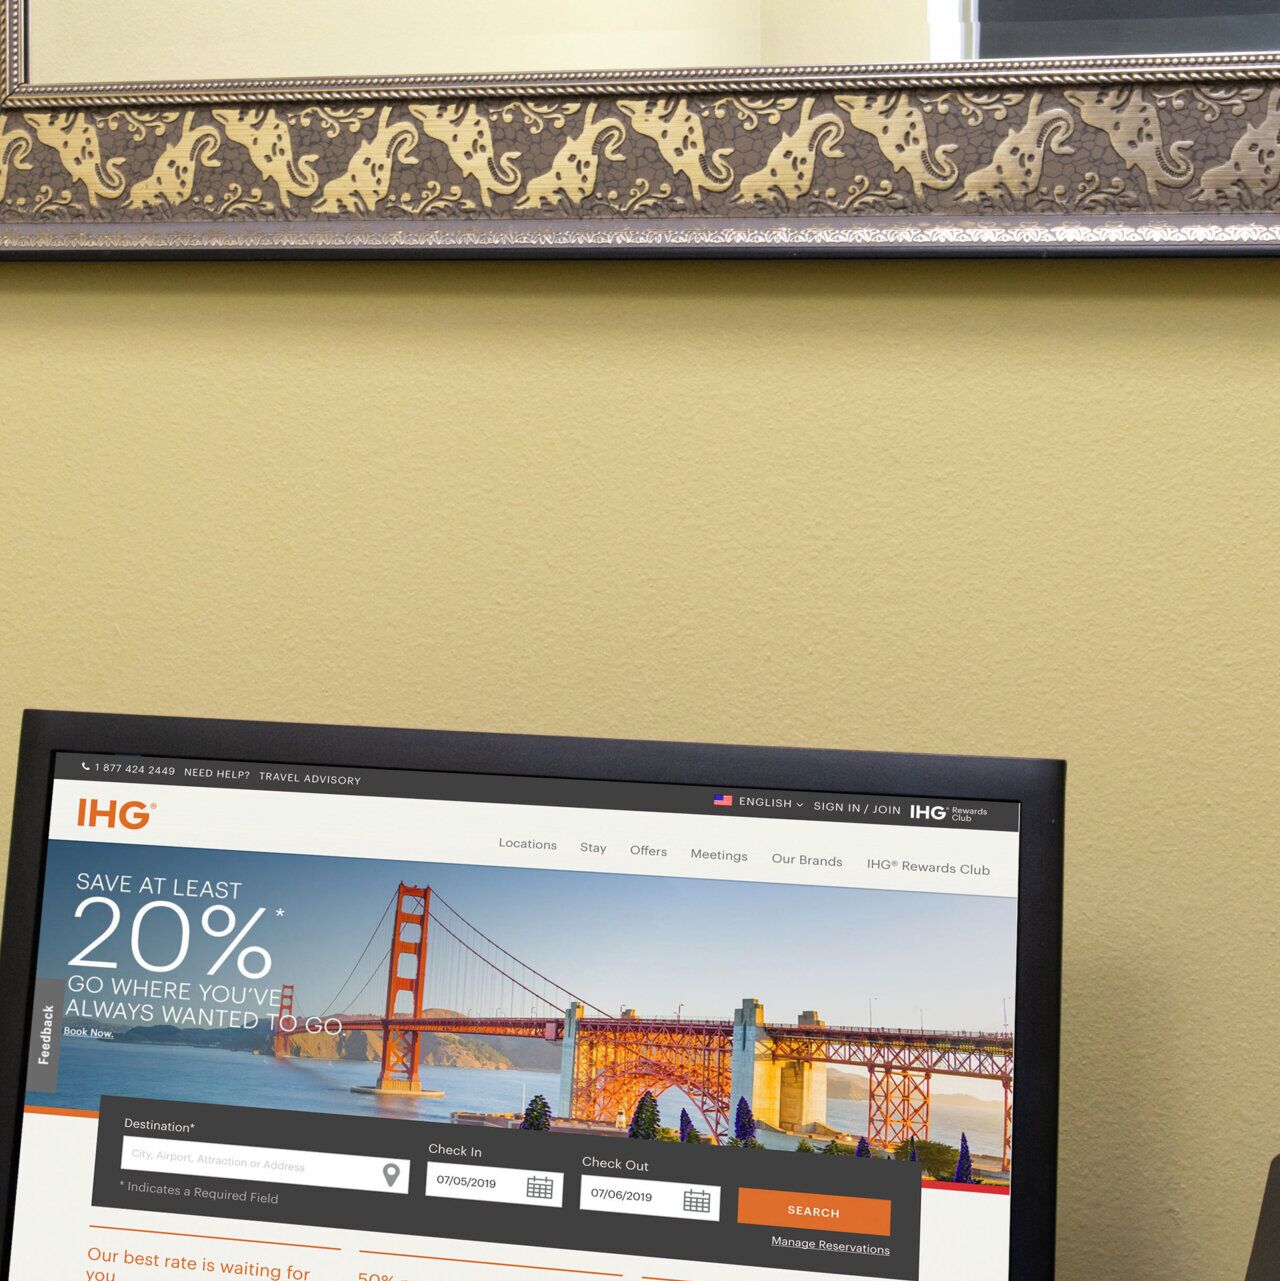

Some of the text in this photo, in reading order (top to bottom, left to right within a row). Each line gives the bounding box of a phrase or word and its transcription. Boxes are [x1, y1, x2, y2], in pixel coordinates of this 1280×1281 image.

[95, 764, 175, 775] 1 877 424 2449
[184, 768, 250, 780] NEED HELP?
[259, 772, 361, 786] TRAVEL ADVISORY
[740, 796, 792, 808] ENGLISH
[814, 802, 845, 812] SIGN
[848, 803, 860, 812] IN
[873, 804, 901, 815] JOIN
[952, 806, 988, 816] Rewards
[952, 814, 972, 822] Club
[499, 838, 557, 850] Locations
[580, 842, 607, 855] Stay
[630, 845, 667, 857] Offers
[691, 848, 748, 863] Meetings
[772, 854, 843, 868] Our Brands
[902, 862, 956, 874] Rewards
[960, 864, 990, 876] Club
[76, 872, 242, 900] SAVE AT LEAST
[68, 975, 104, 994] GO
[111, 978, 191, 1002] WHERE
[65, 998, 346, 1037] ALWAYS WANTED TO GO.
[38, 1004, 55, 1067] Feedback
[63, 1026, 114, 1039] Book Now.
[428, 1143, 482, 1158] Check In
[582, 1156, 648, 1172] Check Out
[436, 1175, 496, 1189] 07/05/2019
[127, 1181, 279, 1204] Indicates a Required Field
[590, 1188, 653, 1202] 07/06/2019
[788, 1205, 840, 1218] SEARCH
[771, 1236, 890, 1256] Manage Reservations
[88, 1247, 311, 1281] Our best rate is waiting for
